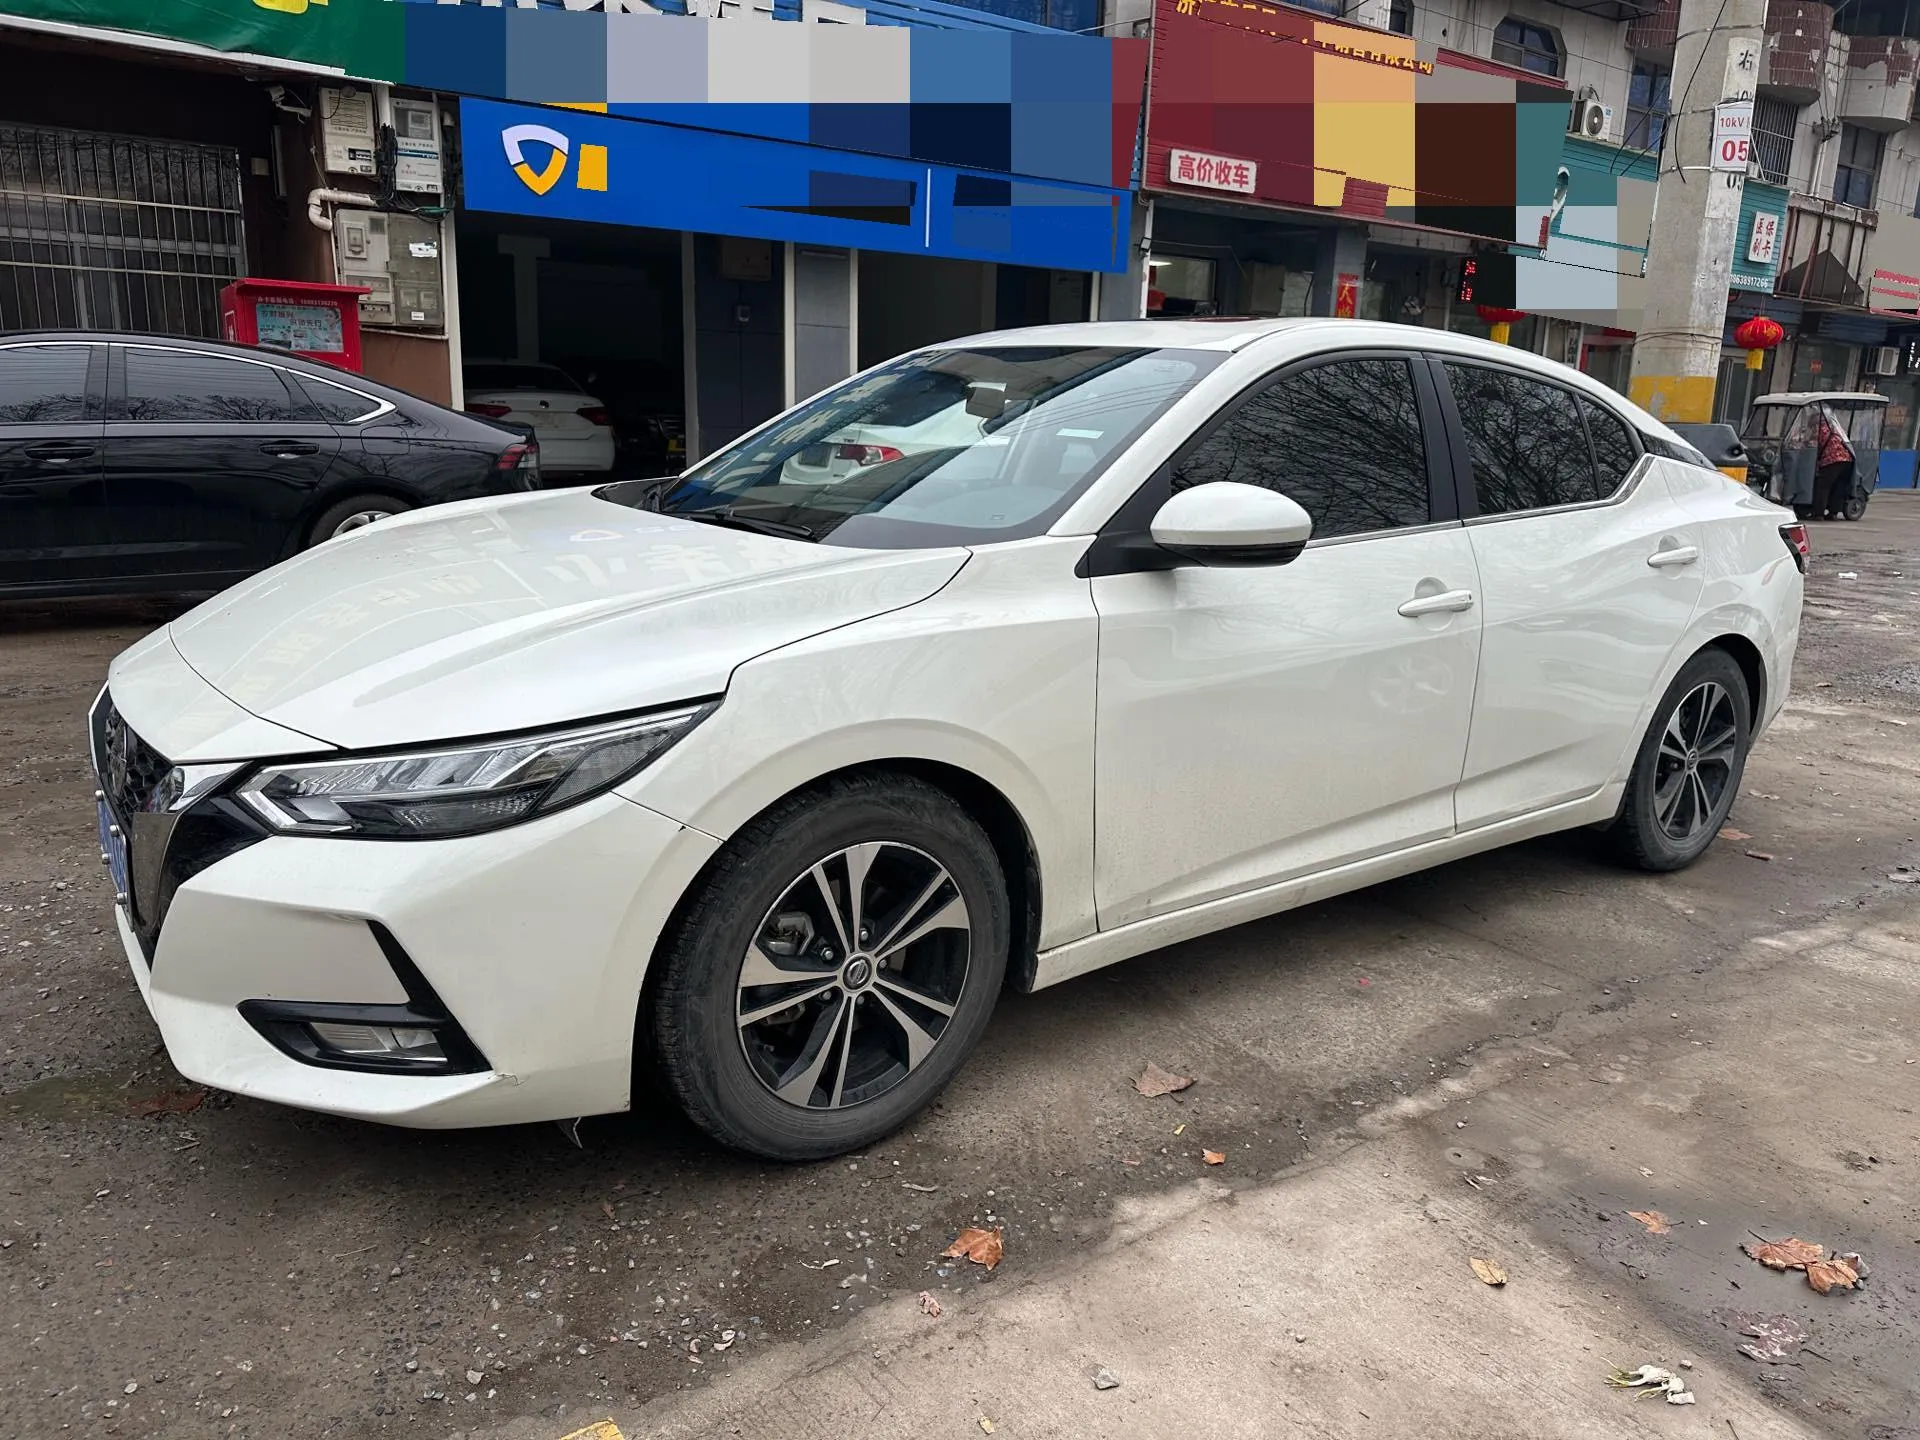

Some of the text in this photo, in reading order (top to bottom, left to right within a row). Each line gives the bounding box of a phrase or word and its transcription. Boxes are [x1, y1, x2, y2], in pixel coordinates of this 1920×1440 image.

[1720, 116, 1745, 128] 10kV
[1722, 140, 1749, 162] 05
[1178, 154, 1250, 189] 高价收车
